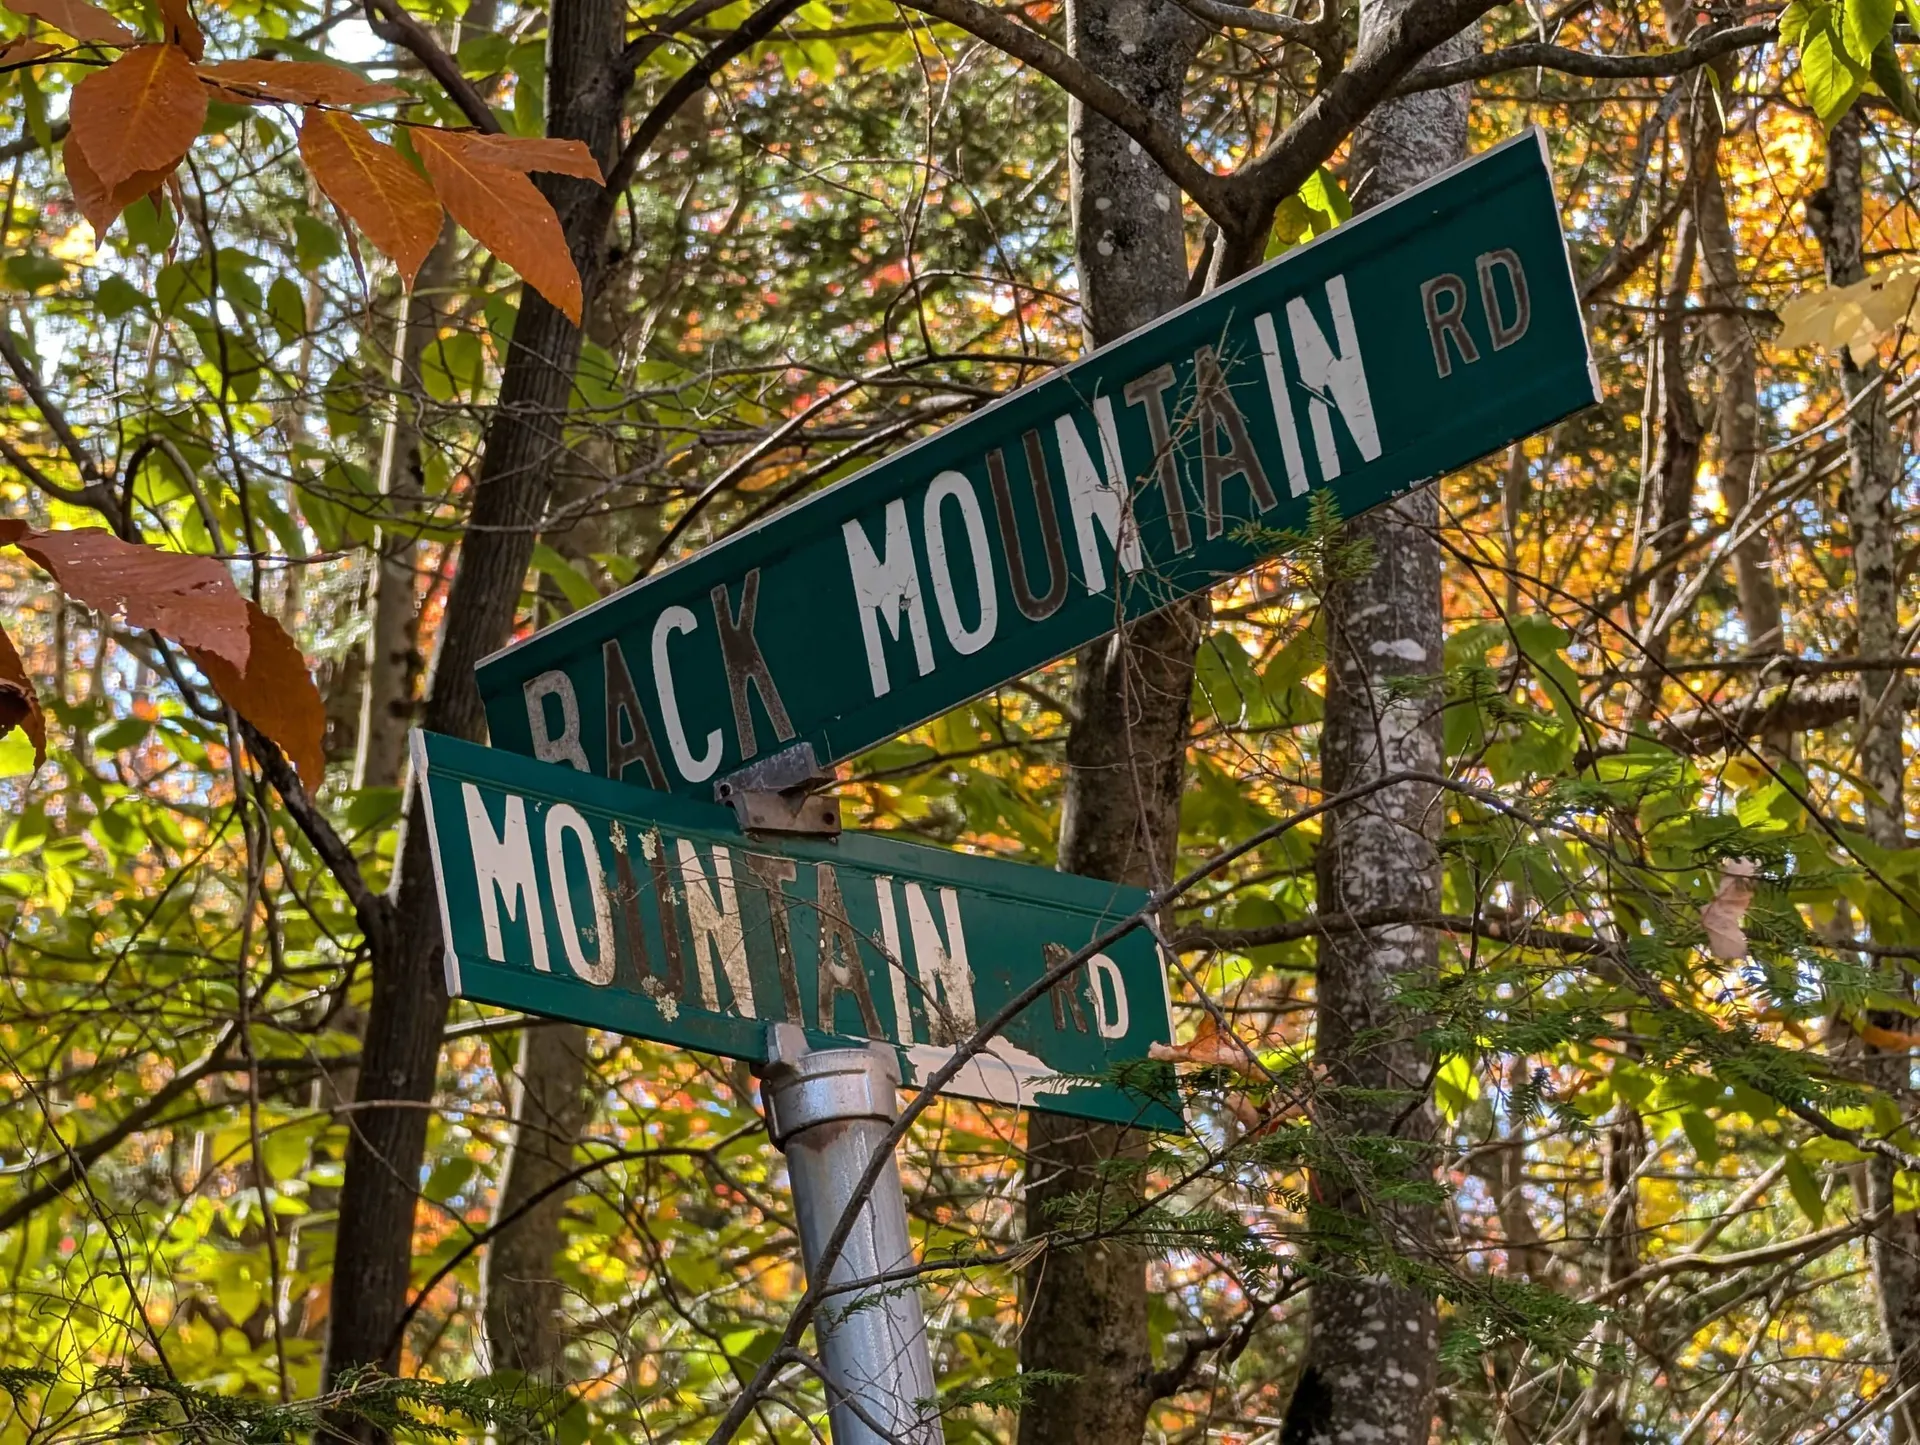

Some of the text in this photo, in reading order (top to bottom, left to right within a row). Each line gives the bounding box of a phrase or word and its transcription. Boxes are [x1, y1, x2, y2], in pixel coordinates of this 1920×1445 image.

[842, 274, 1382, 698] MOUNTAIN
[1420, 247, 1530, 378] RD
[461, 782, 1129, 1047] MOUNTAIN RD
